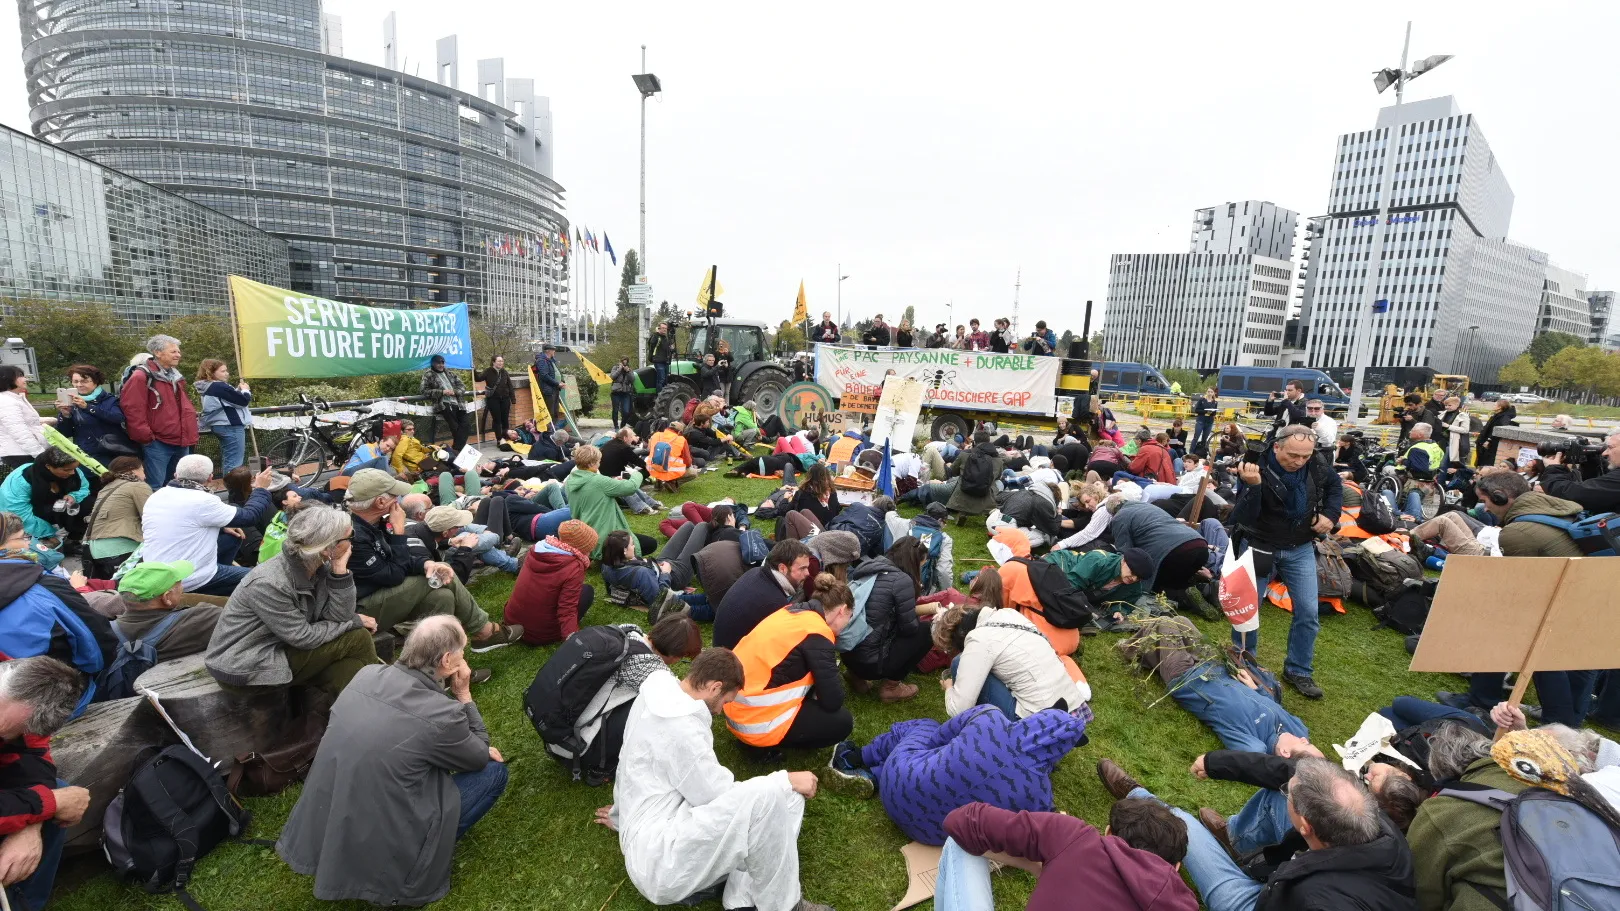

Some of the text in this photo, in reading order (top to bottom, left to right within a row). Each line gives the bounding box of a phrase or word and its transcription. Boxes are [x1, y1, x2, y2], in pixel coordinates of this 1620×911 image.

[284, 297, 456, 334] SERVE UP A BETTER
[266, 327, 365, 358] FUTURE
[371, 333, 406, 359] FOR
[854, 351, 879, 363] PAC
[892, 351, 959, 366] PAYSANNE
[976, 355, 1036, 370] DURABLE
[1002, 391, 1031, 407] GAP
[1225, 603, 1254, 616] nature
